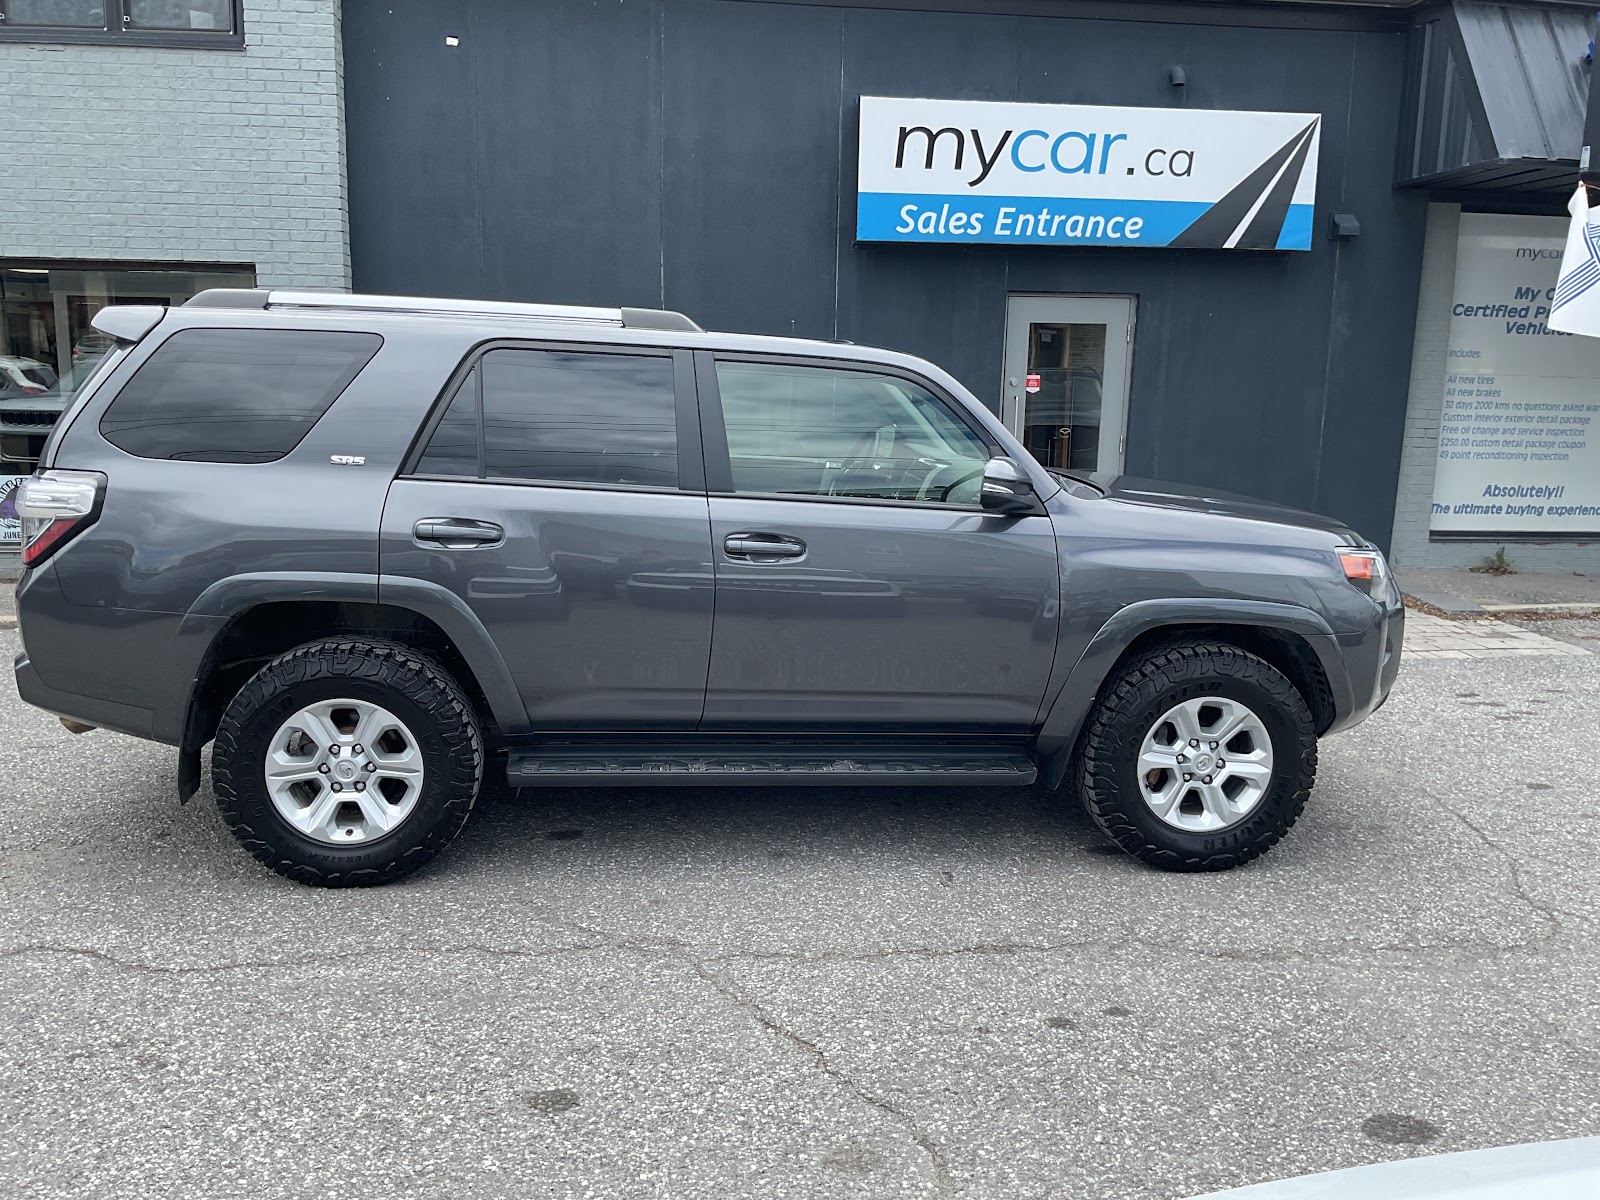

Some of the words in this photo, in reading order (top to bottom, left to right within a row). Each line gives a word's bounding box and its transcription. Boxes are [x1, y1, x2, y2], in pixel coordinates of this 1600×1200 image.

[896, 204, 984, 236] Sales
[993, 206, 1144, 239] Entrance
[1514, 286, 1541, 302] My
[1452, 303, 1530, 319] Certified
[1447, 375, 1457, 384] All
[1458, 376, 1475, 385] new
[1477, 375, 1495, 385] tires
[1445, 387, 1456, 397] All
[1457, 388, 1474, 397] new
[1475, 387, 1502, 398] brakes
[1444, 400, 1455, 409] 30
[1455, 400, 1473, 411] days
[1474, 401, 1494, 410] 2000
[1494, 401, 1510, 411] kms
[1511, 403, 1522, 411] no
[1523, 402, 1561, 412] questions
[1562, 403, 1584, 412] asked
[1442, 412, 1473, 422] Custom
[1474, 413, 1503, 423] interior
[1504, 414, 1535, 424] exterior
[1536, 414, 1558, 424] detail
[1559, 415, 1591, 426] package
[1441, 425, 1459, 435] Free
[1460, 425, 1471, 435] oil
[1472, 425, 1500, 437] change
[1501, 426, 1516, 436] and
[1517, 427, 1544, 437] service
[1545, 427, 1585, 438] inspection
[1440, 437, 1470, 447] $250.00
[1471, 438, 1500, 448] custom
[1501, 438, 1524, 449] detail
[1525, 439, 1556, 450] package
[1557, 440, 1586, 450] coupon
[1449, 450, 1471, 460] point
[1472, 451, 1529, 462] reconditioning
[1529, 451, 1569, 461] inspection
[1482, 484, 1565, 500] Absolutely!!
[1430, 503, 1450, 514] The
[1453, 503, 1503, 515] ultimate
[1505, 504, 1544, 516] buying
